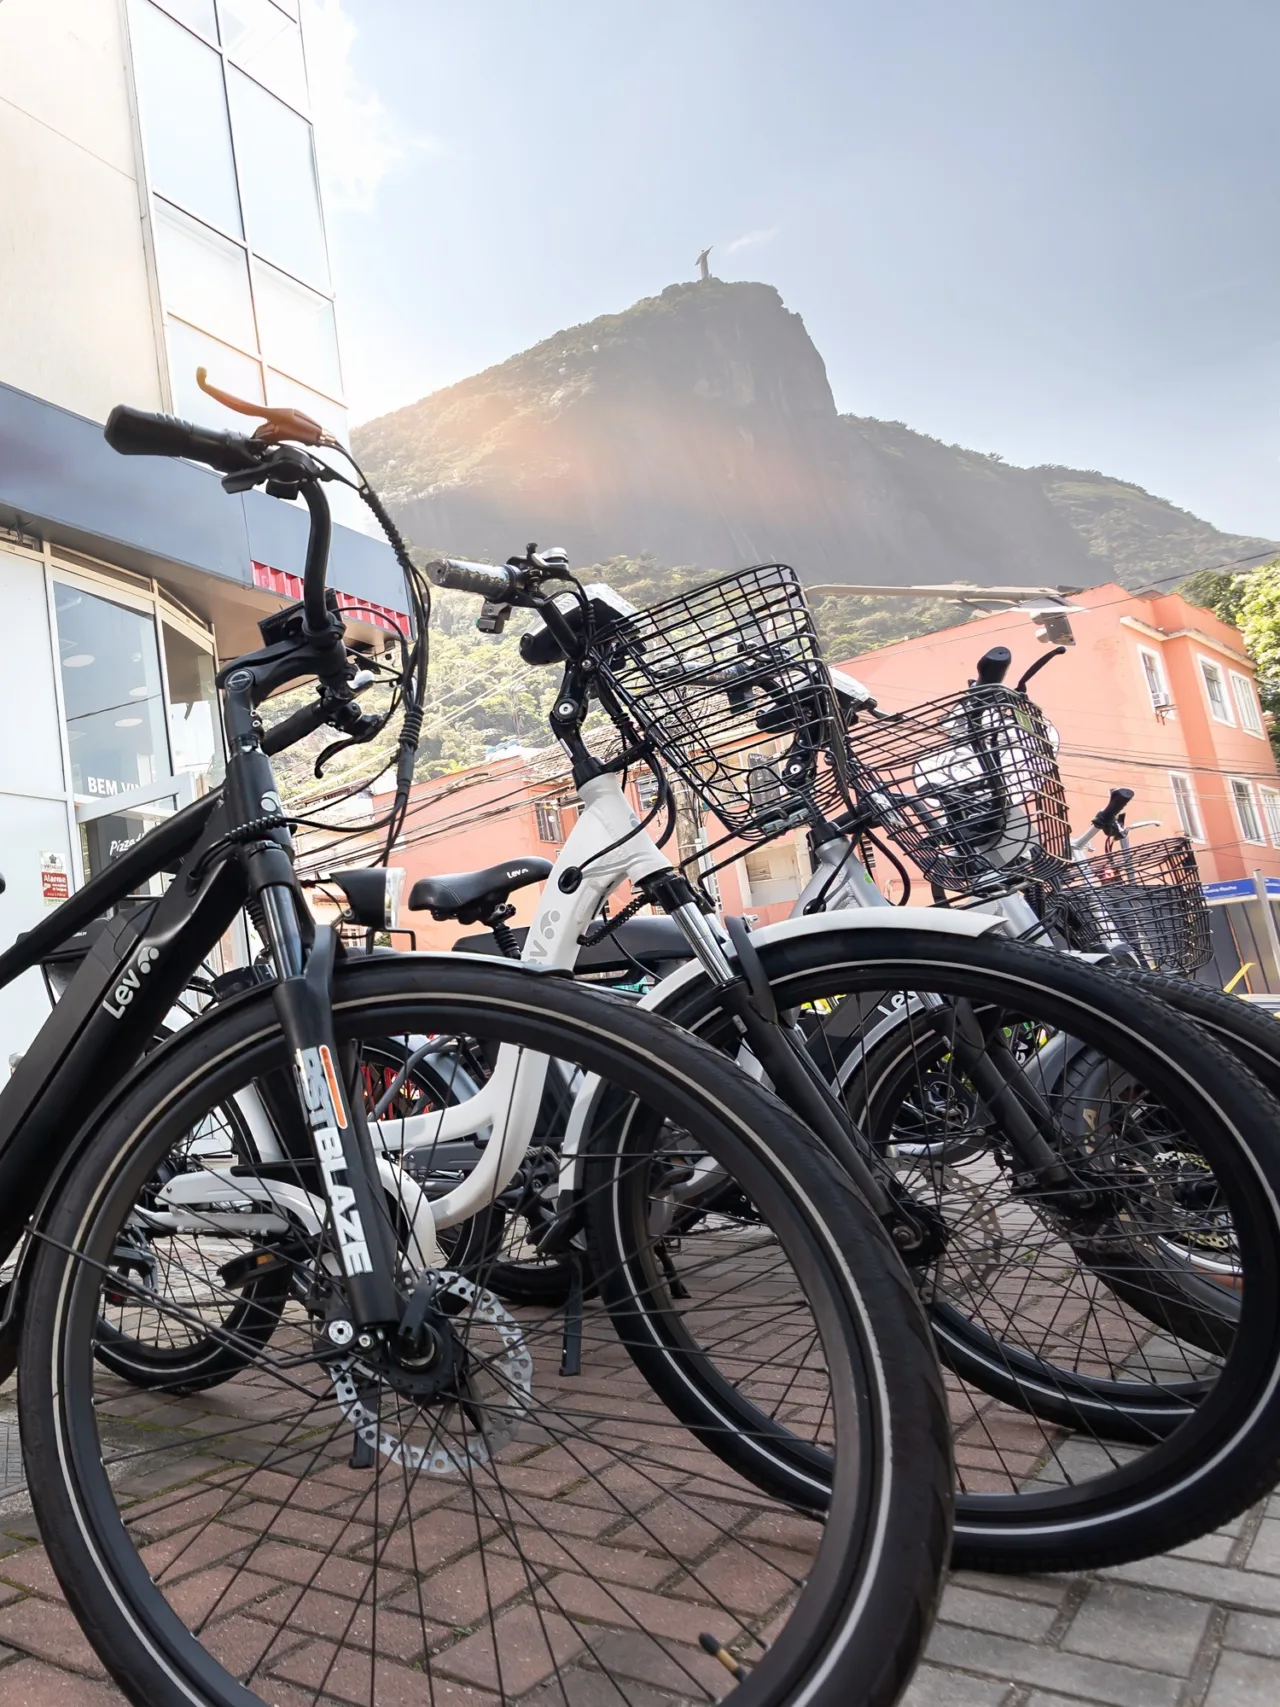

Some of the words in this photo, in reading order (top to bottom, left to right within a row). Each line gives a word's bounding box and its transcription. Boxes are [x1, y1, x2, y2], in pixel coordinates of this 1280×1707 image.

[88, 776, 118, 796] BEM
[109, 839, 136, 856] Pizza
[102, 968, 141, 1019] Lev
[313, 1126, 374, 1278] BLAZE
